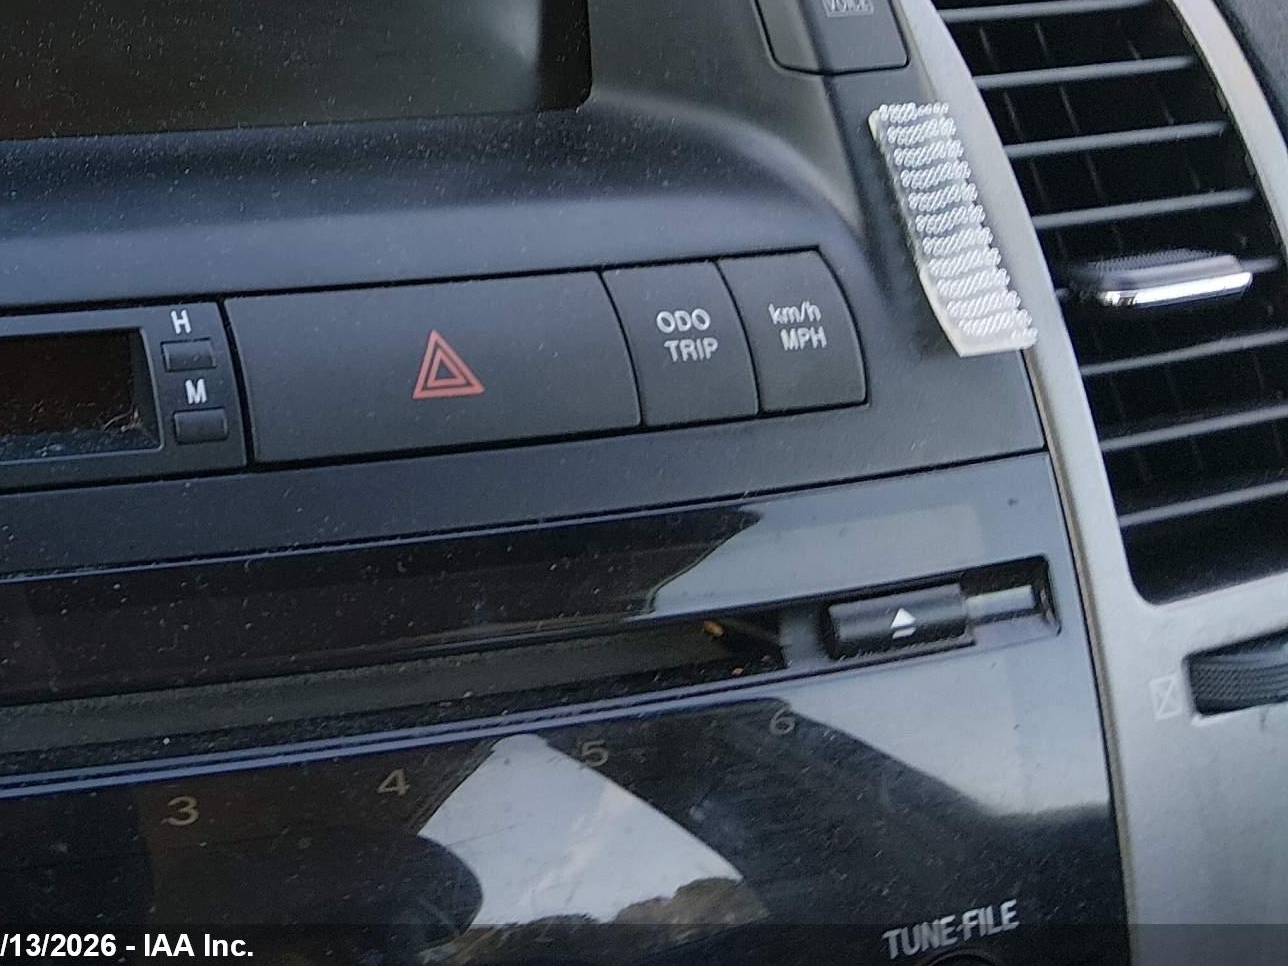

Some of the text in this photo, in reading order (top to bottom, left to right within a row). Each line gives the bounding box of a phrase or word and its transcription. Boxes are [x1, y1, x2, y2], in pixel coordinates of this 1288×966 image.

[170, 309, 192, 335] H
[656, 308, 711, 334] ODO
[768, 300, 822, 325] km/h
[664, 337, 719, 362] TRIP
[780, 326, 827, 351] MPH
[185, 378, 207, 405] M
[161, 796, 200, 826] 3
[377, 768, 411, 796] 4
[580, 739, 610, 768] 5
[769, 707, 796, 735] 6
